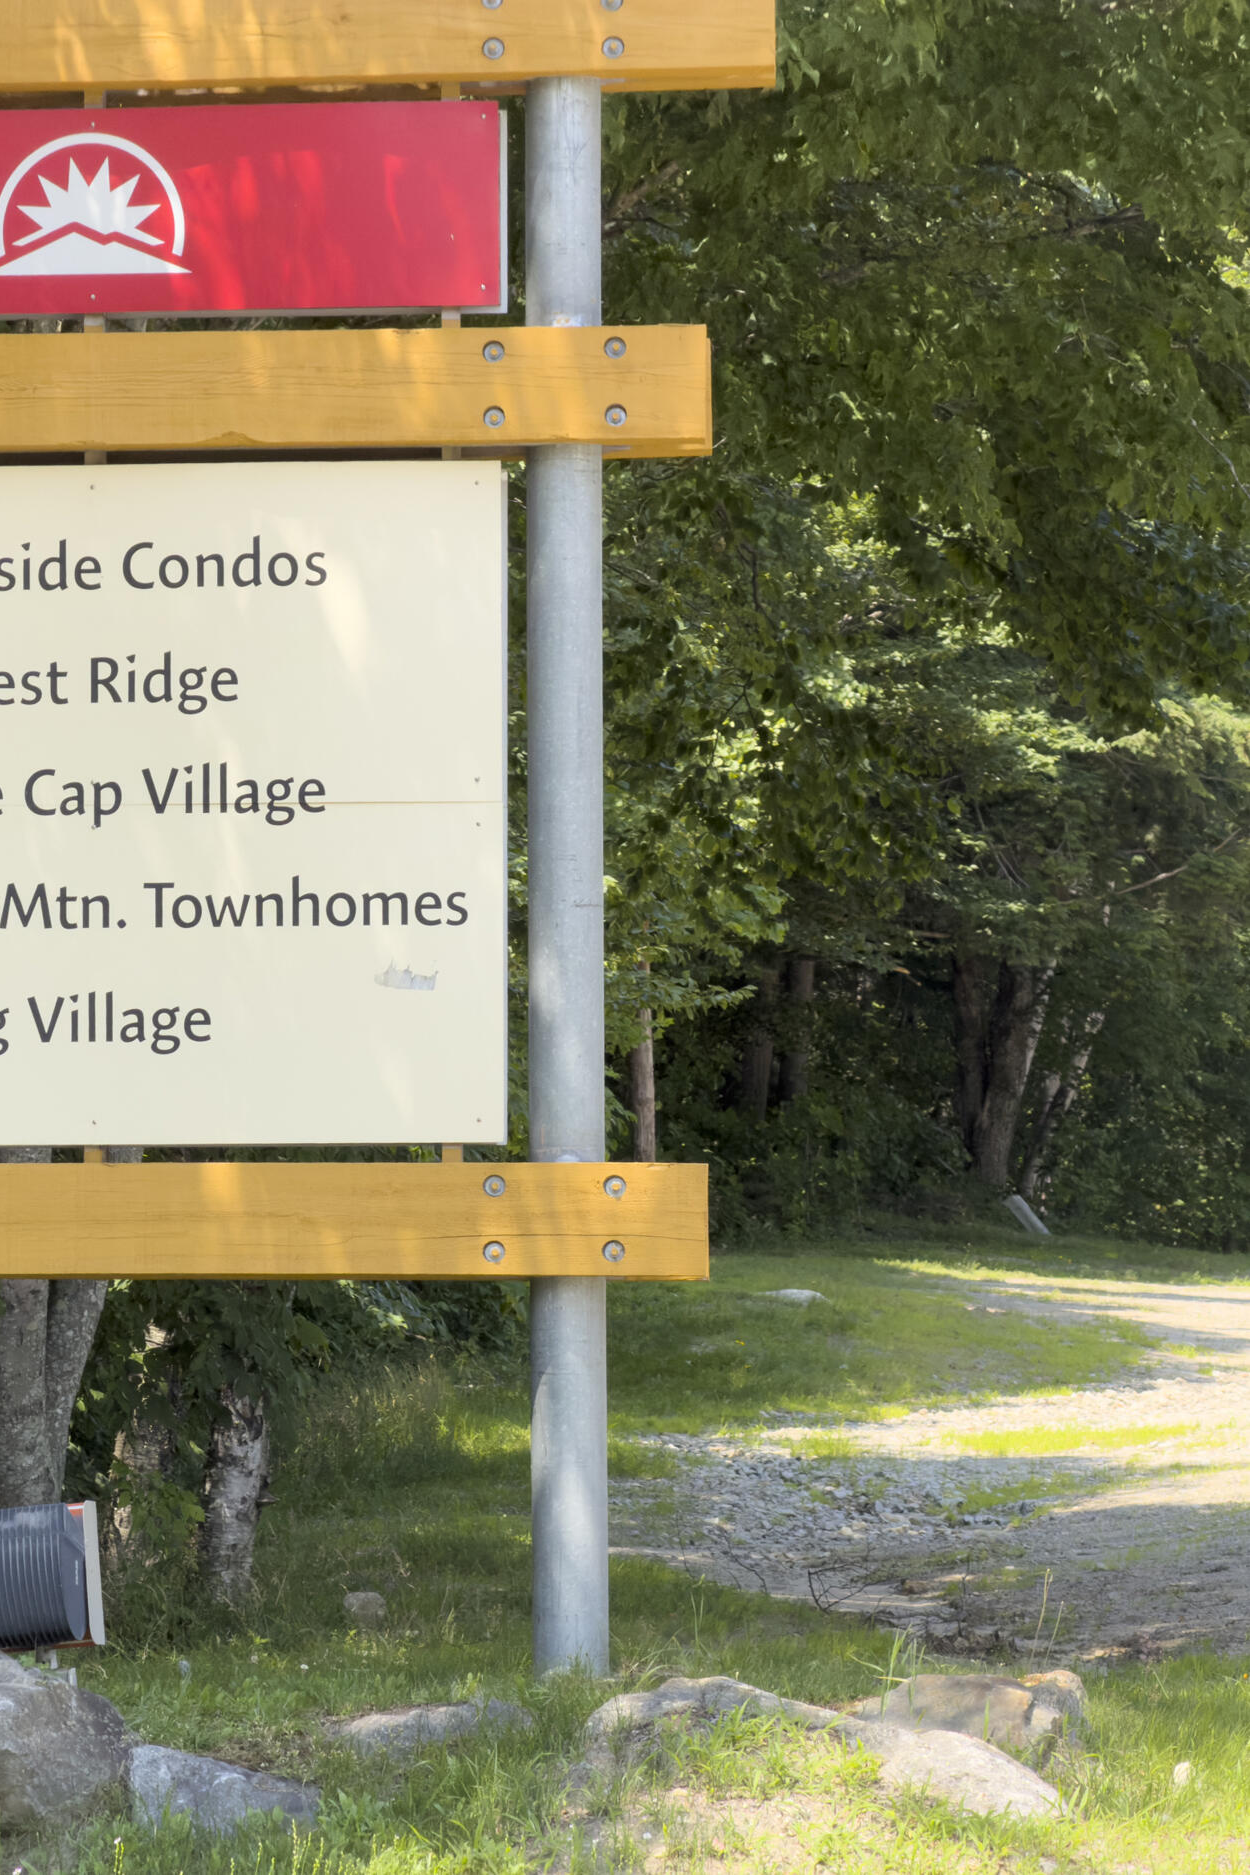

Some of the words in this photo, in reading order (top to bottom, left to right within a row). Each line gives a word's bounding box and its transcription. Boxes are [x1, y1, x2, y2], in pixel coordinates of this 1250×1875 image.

[123, 536, 327, 590] Condos
[90, 652, 239, 715] Ridge
[24, 769, 122, 828] Cap
[141, 763, 327, 826] Village
[0, 884, 127, 930] Mtn.
[144, 876, 469, 929] Townhomes
[28, 992, 212, 1055] Village
